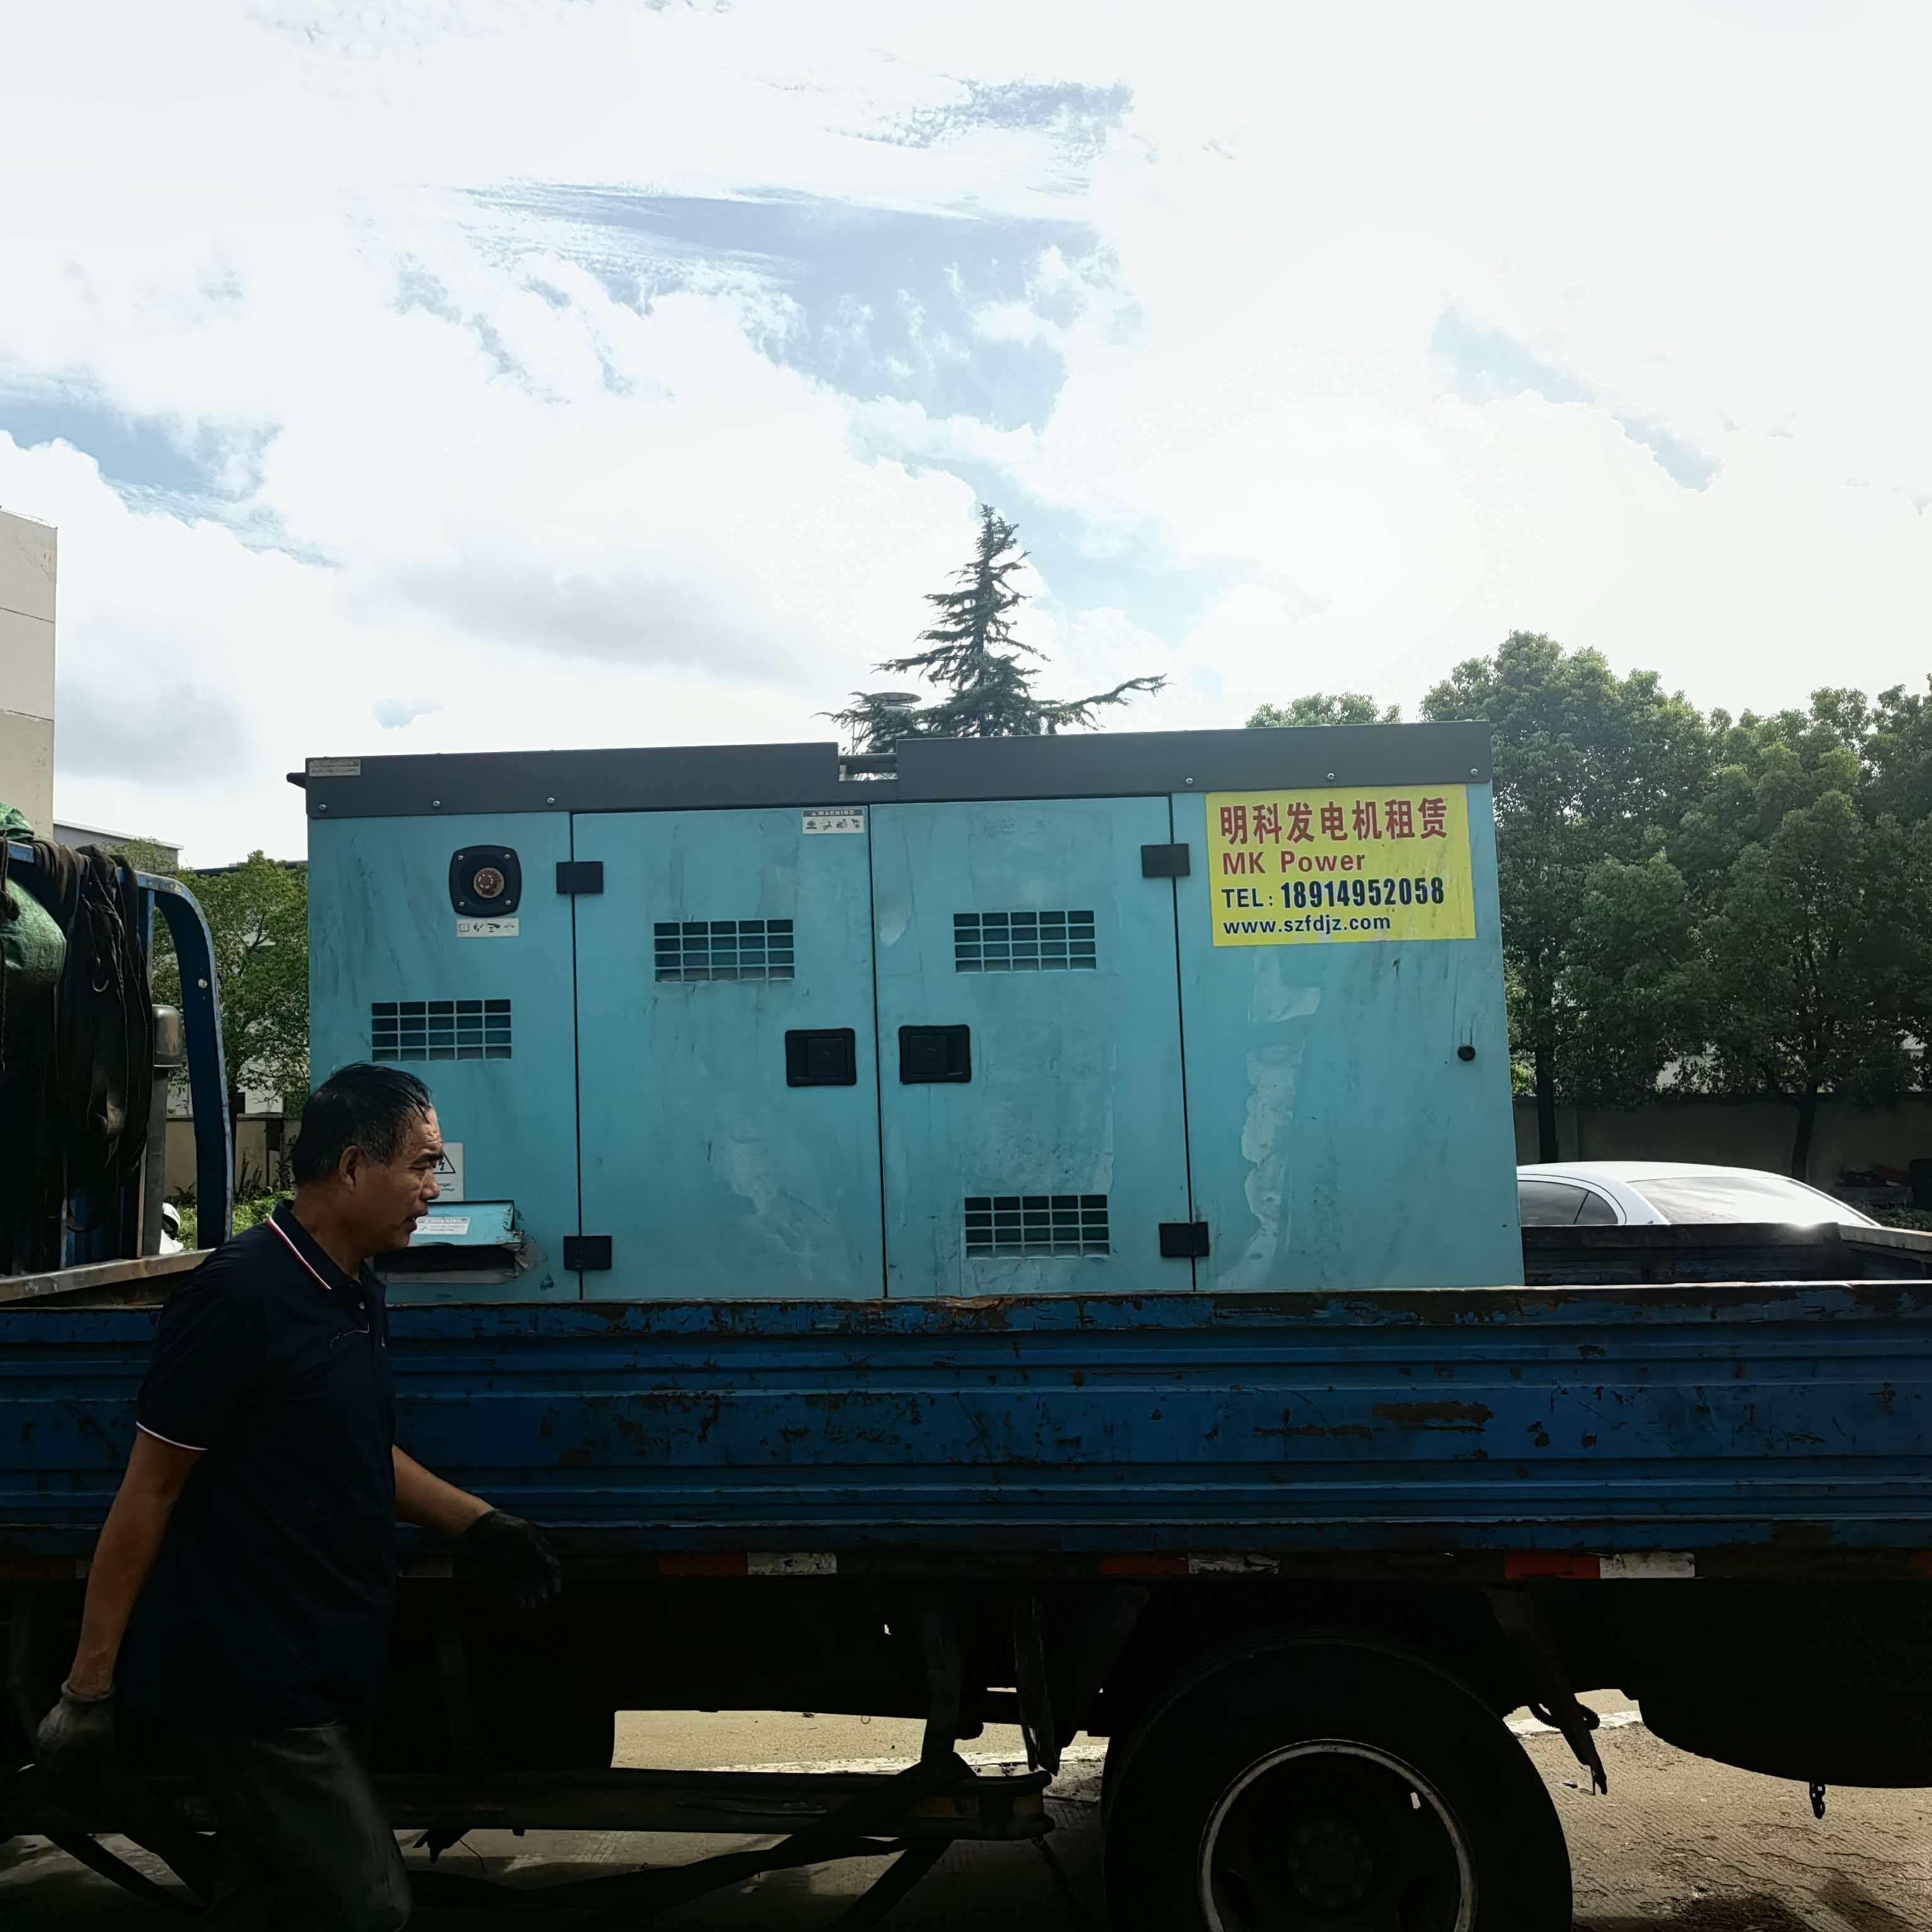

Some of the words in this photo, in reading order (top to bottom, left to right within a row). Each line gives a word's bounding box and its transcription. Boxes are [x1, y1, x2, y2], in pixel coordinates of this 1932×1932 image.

[1220, 797, 1446, 845] 明科发电机租赁
[1223, 851, 1265, 875] MK
[1280, 850, 1365, 873] Power
[1280, 877, 1444, 908] 18914952058
[1223, 914, 1391, 935] www.szfdjz.com
